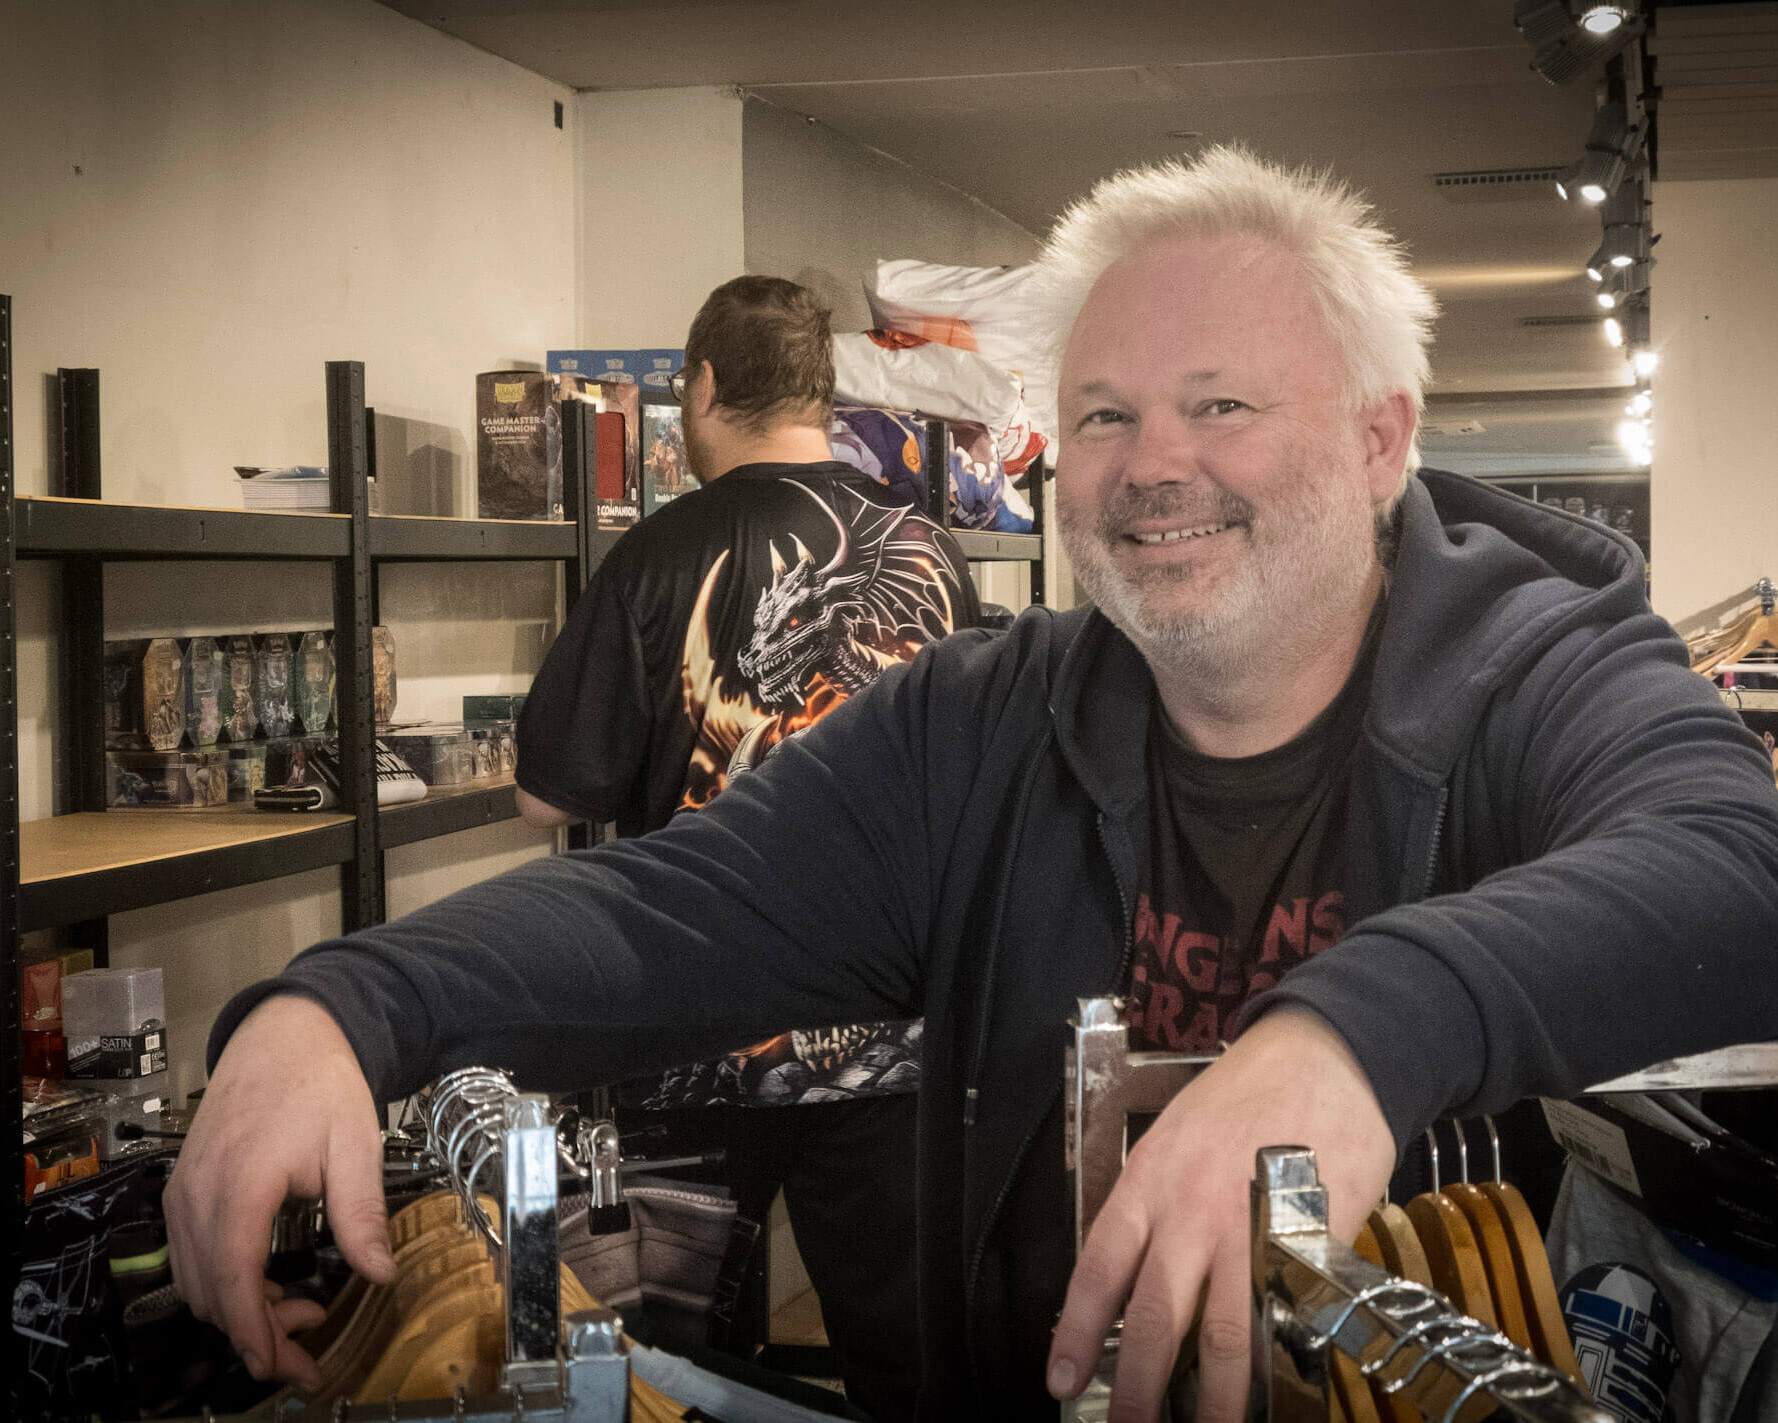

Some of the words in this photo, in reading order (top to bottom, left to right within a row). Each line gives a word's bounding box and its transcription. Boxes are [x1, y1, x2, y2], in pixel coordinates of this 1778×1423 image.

[506, 416, 540, 424] MASTER
[485, 425, 537, 433] COMPANION
[553, 503, 564, 515] GA
[601, 504, 637, 517] COMPANION
[101, 1038, 132, 1049] SATIN
